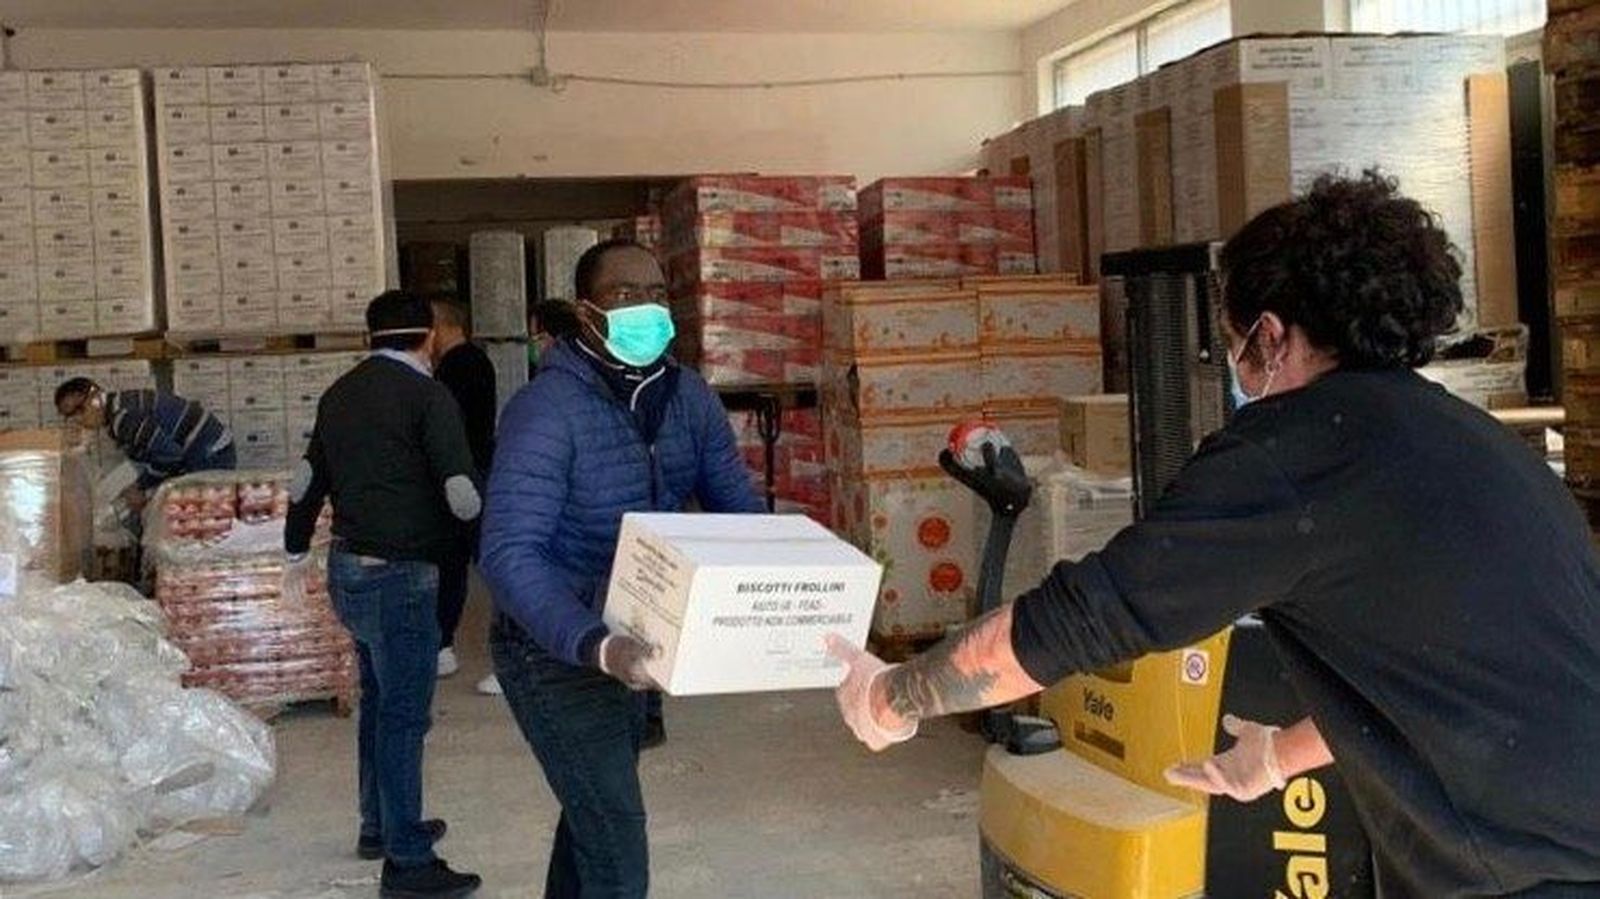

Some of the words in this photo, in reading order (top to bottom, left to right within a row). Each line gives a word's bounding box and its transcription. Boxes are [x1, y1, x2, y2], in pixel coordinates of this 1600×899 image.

[737, 582, 792, 594] BISCOTTI
[794, 582, 846, 593] FROLLINI
[712, 615, 763, 627] PRODOTTO
[765, 615, 783, 626] NON
[1083, 687, 1114, 722] Yale
[1273, 777, 1330, 899] ale
